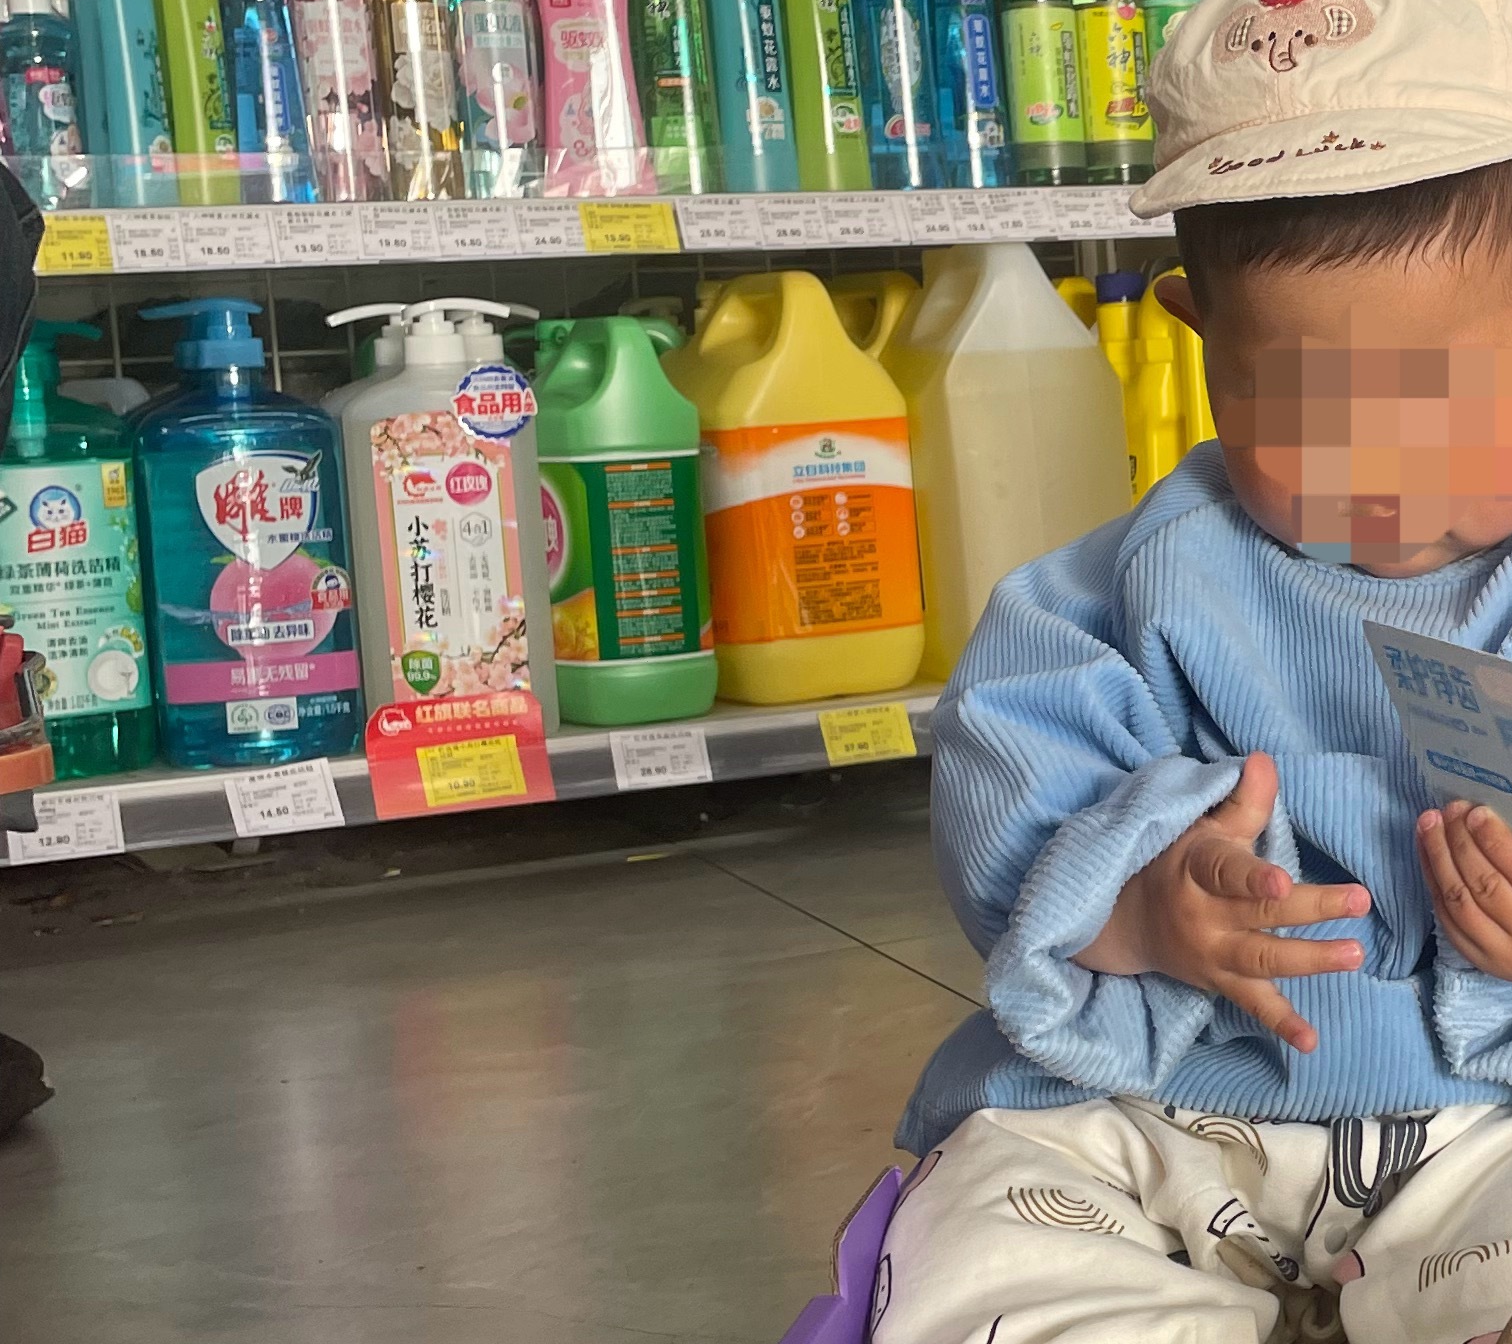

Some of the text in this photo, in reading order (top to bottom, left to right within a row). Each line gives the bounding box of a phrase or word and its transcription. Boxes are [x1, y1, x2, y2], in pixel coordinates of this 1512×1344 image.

[1208, 149, 1285, 176] Good
[454, 391, 523, 416] 食品用
[27, 520, 88, 553] 白猫
[407, 515, 439, 630] 小苏打樱花
